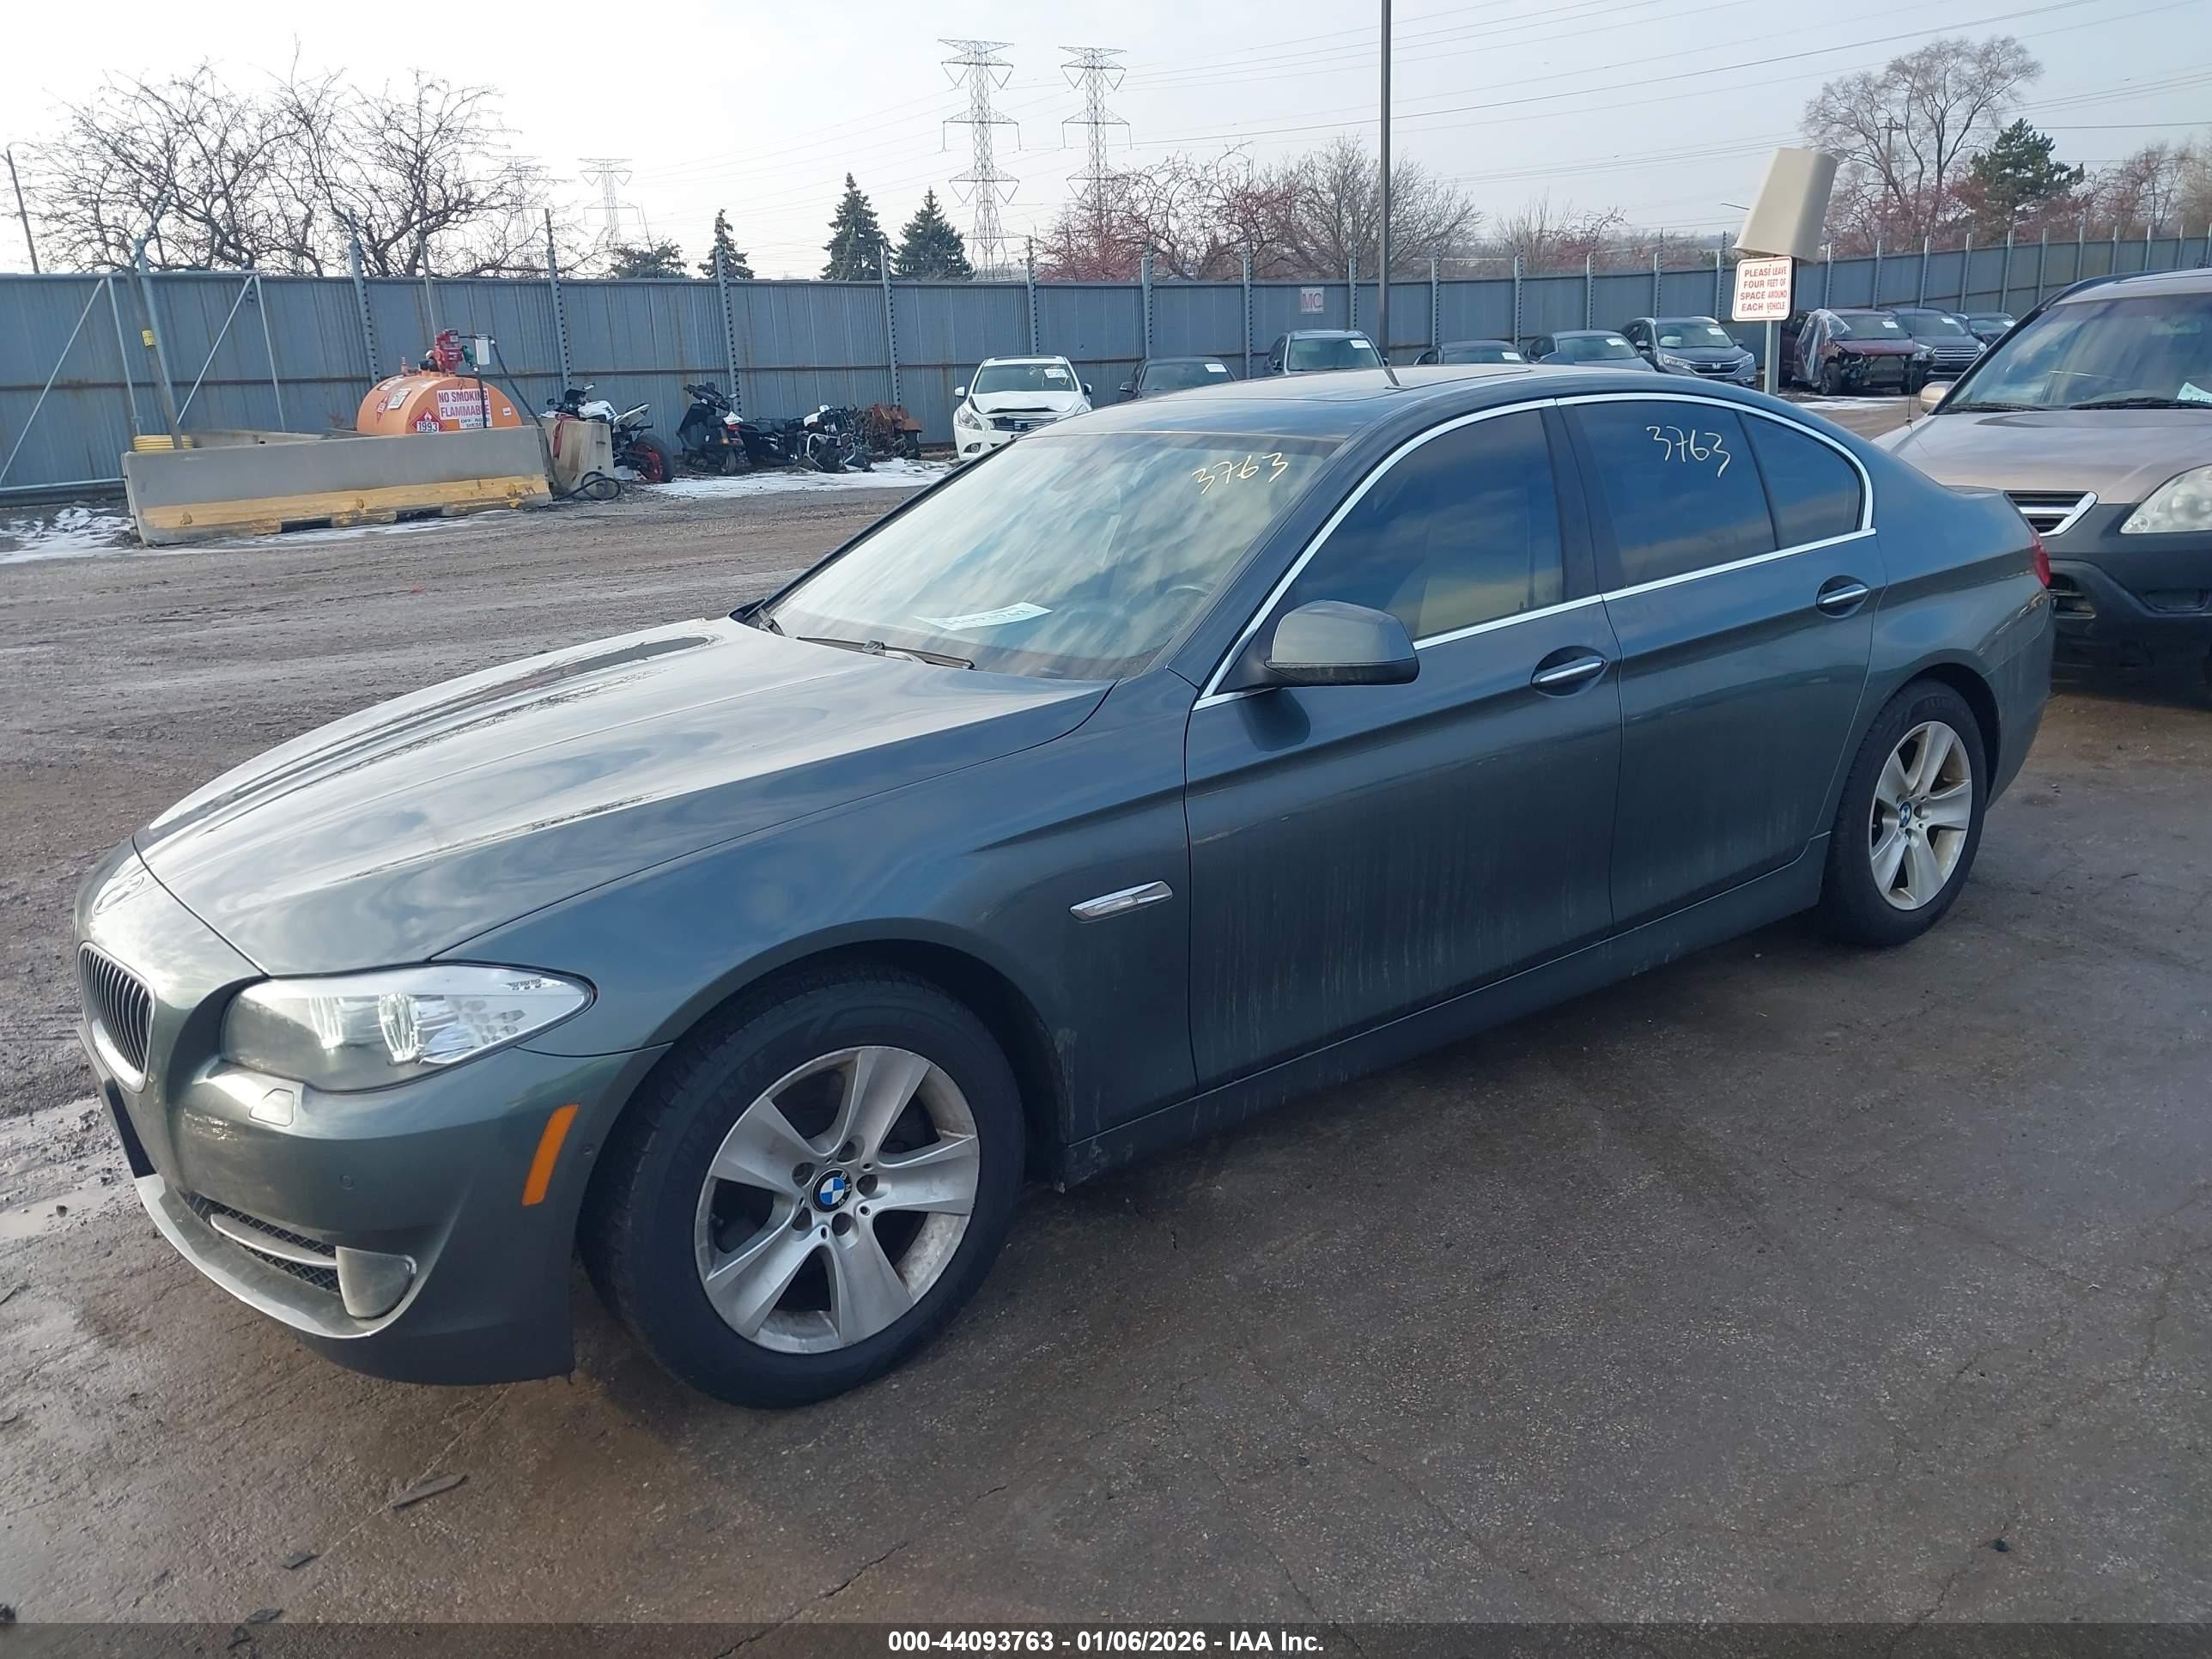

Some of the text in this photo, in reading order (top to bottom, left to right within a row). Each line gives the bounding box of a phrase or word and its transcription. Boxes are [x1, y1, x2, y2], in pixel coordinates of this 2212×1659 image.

[1744, 266, 1787, 277] PLEASE LEAVE
[1743, 278, 1786, 289] FOUR FEET OF
[1302, 292, 1322, 309] MC
[1740, 290, 1787, 301] SPACE AROUND
[1741, 301, 1785, 312] EACH VEHICLE
[438, 392, 449, 403] NO
[441, 404, 490, 417] FLAMMABE
[418, 422, 438, 432] 1993
[1646, 425, 1731, 478] 3763
[1191, 452, 1289, 495] 3763
